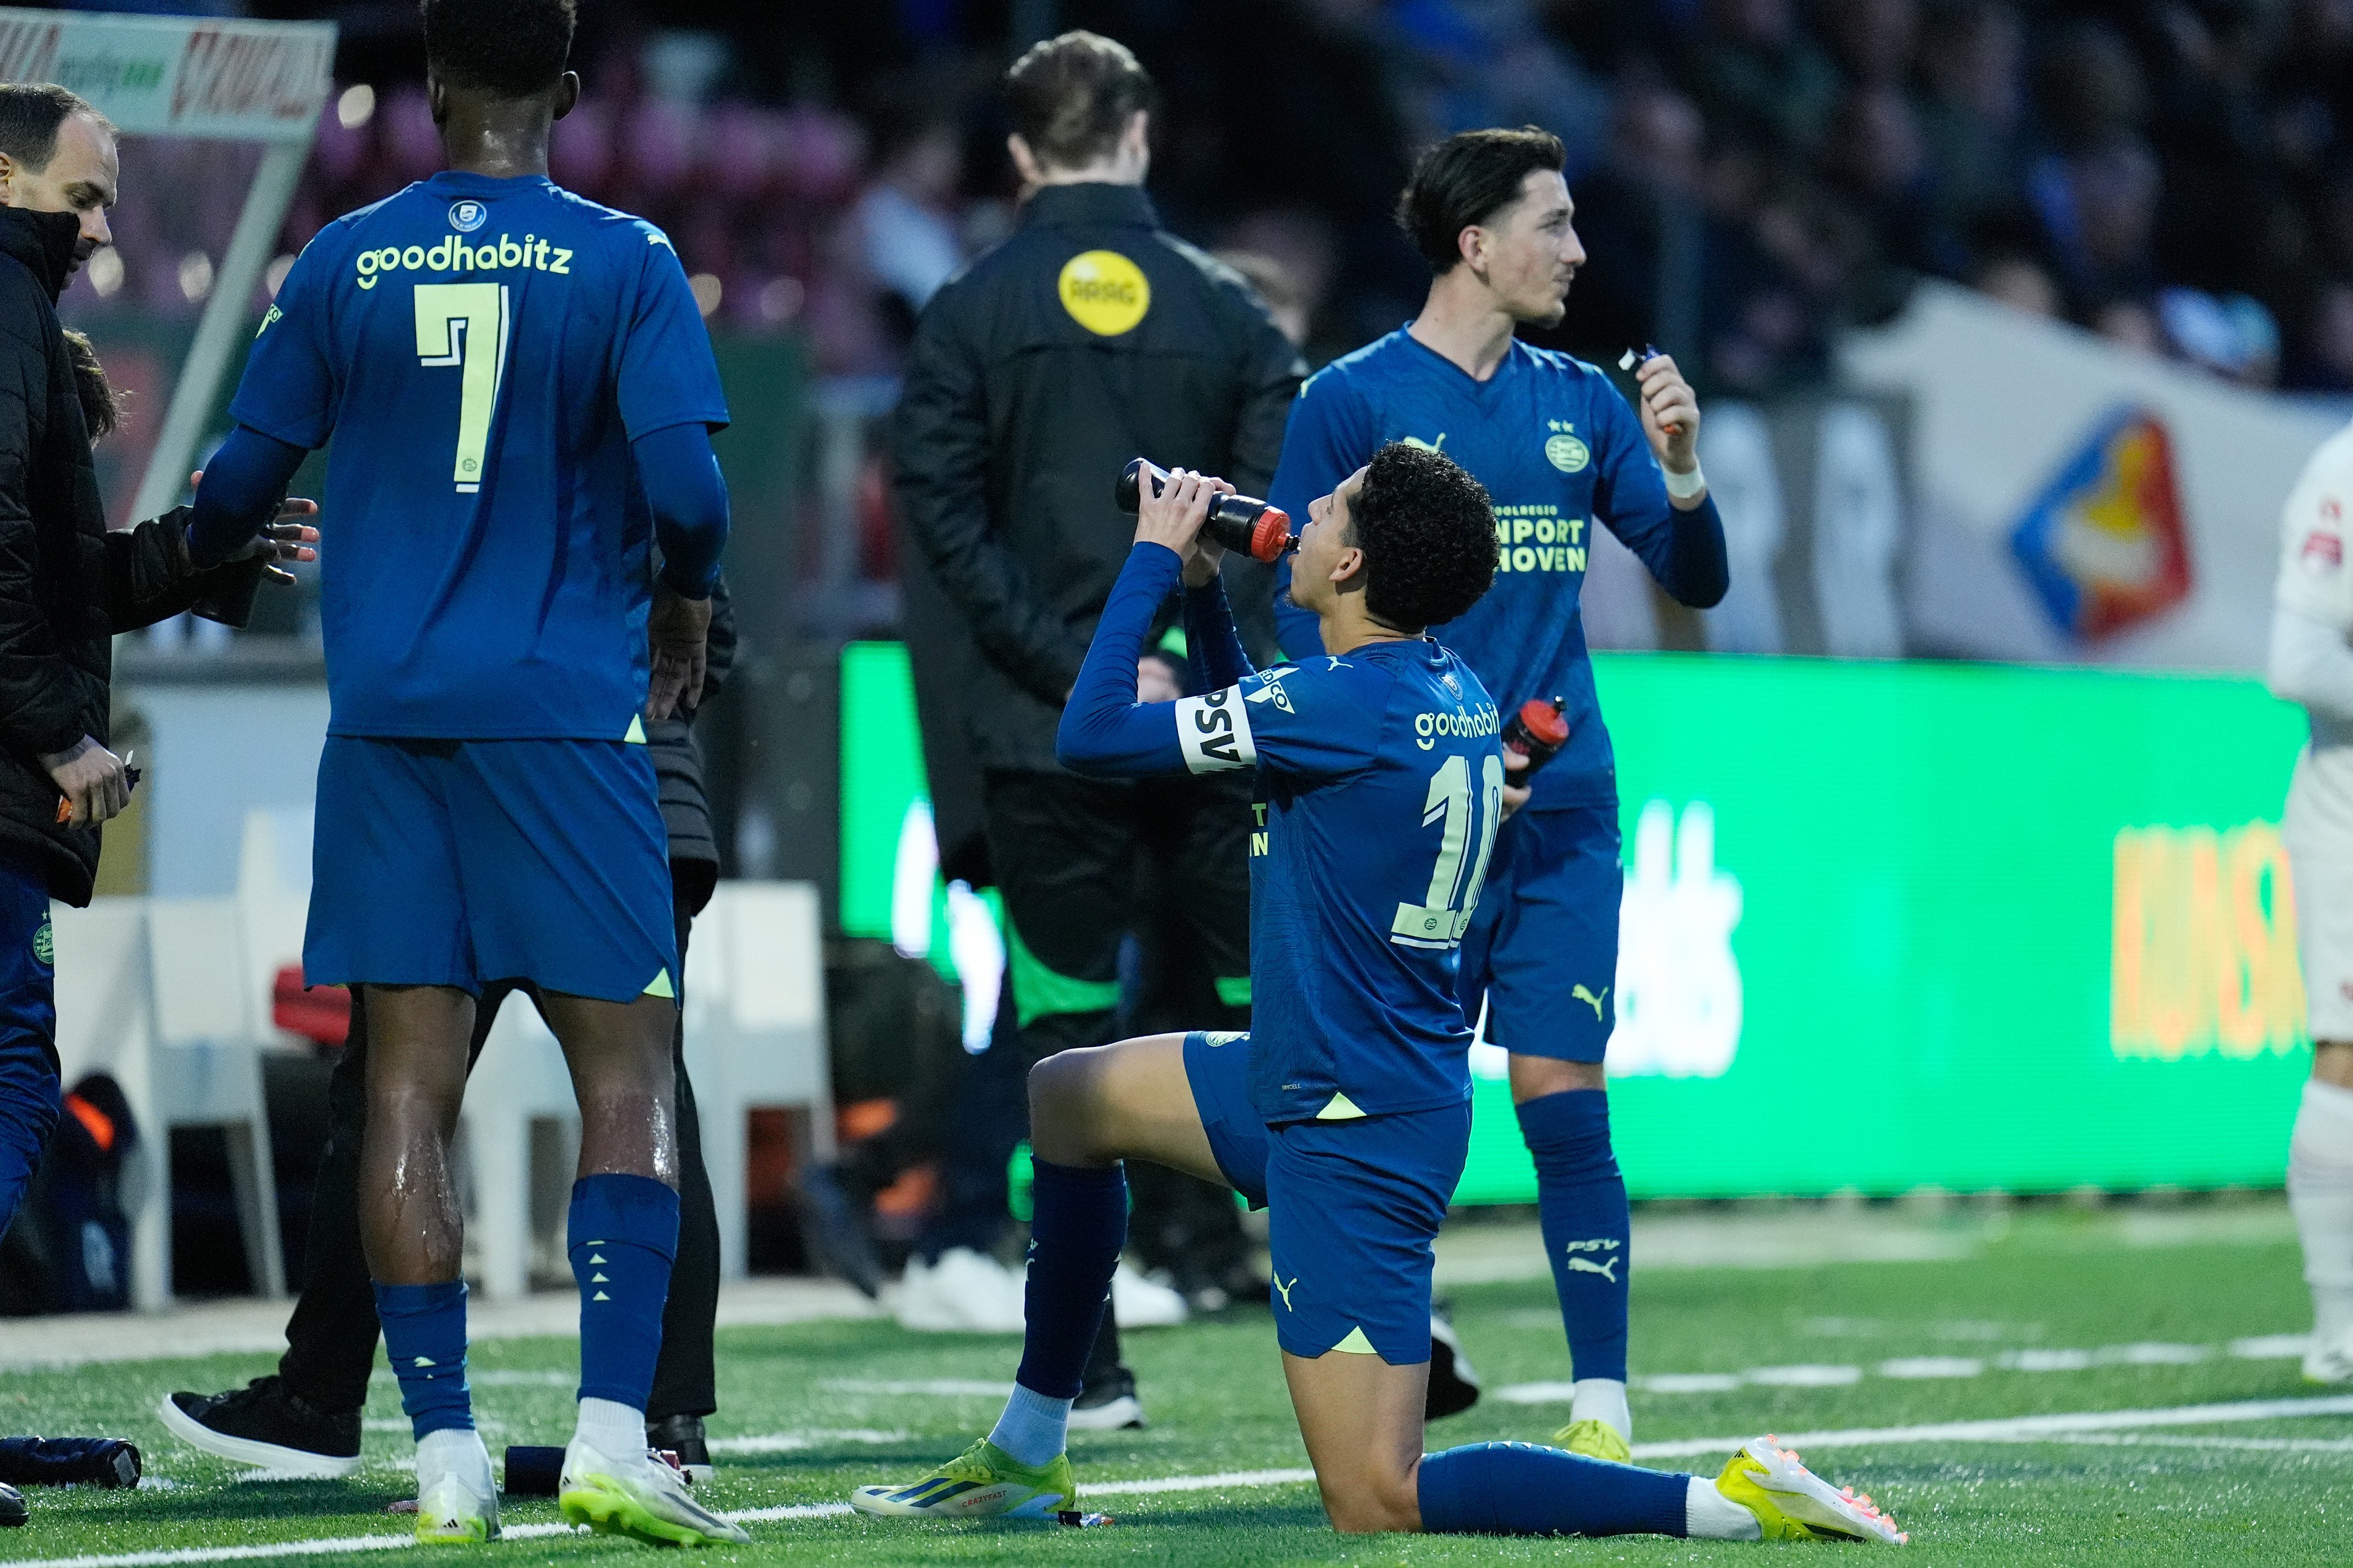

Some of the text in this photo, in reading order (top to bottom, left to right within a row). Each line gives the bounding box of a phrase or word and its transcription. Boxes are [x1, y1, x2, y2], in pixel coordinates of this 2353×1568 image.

[356, 233, 573, 290] goodhabitz
[414, 282, 509, 493] 7
[1195, 688, 1242, 763] PSV
[962, 1490, 1007, 1508] CRAZYFAST
